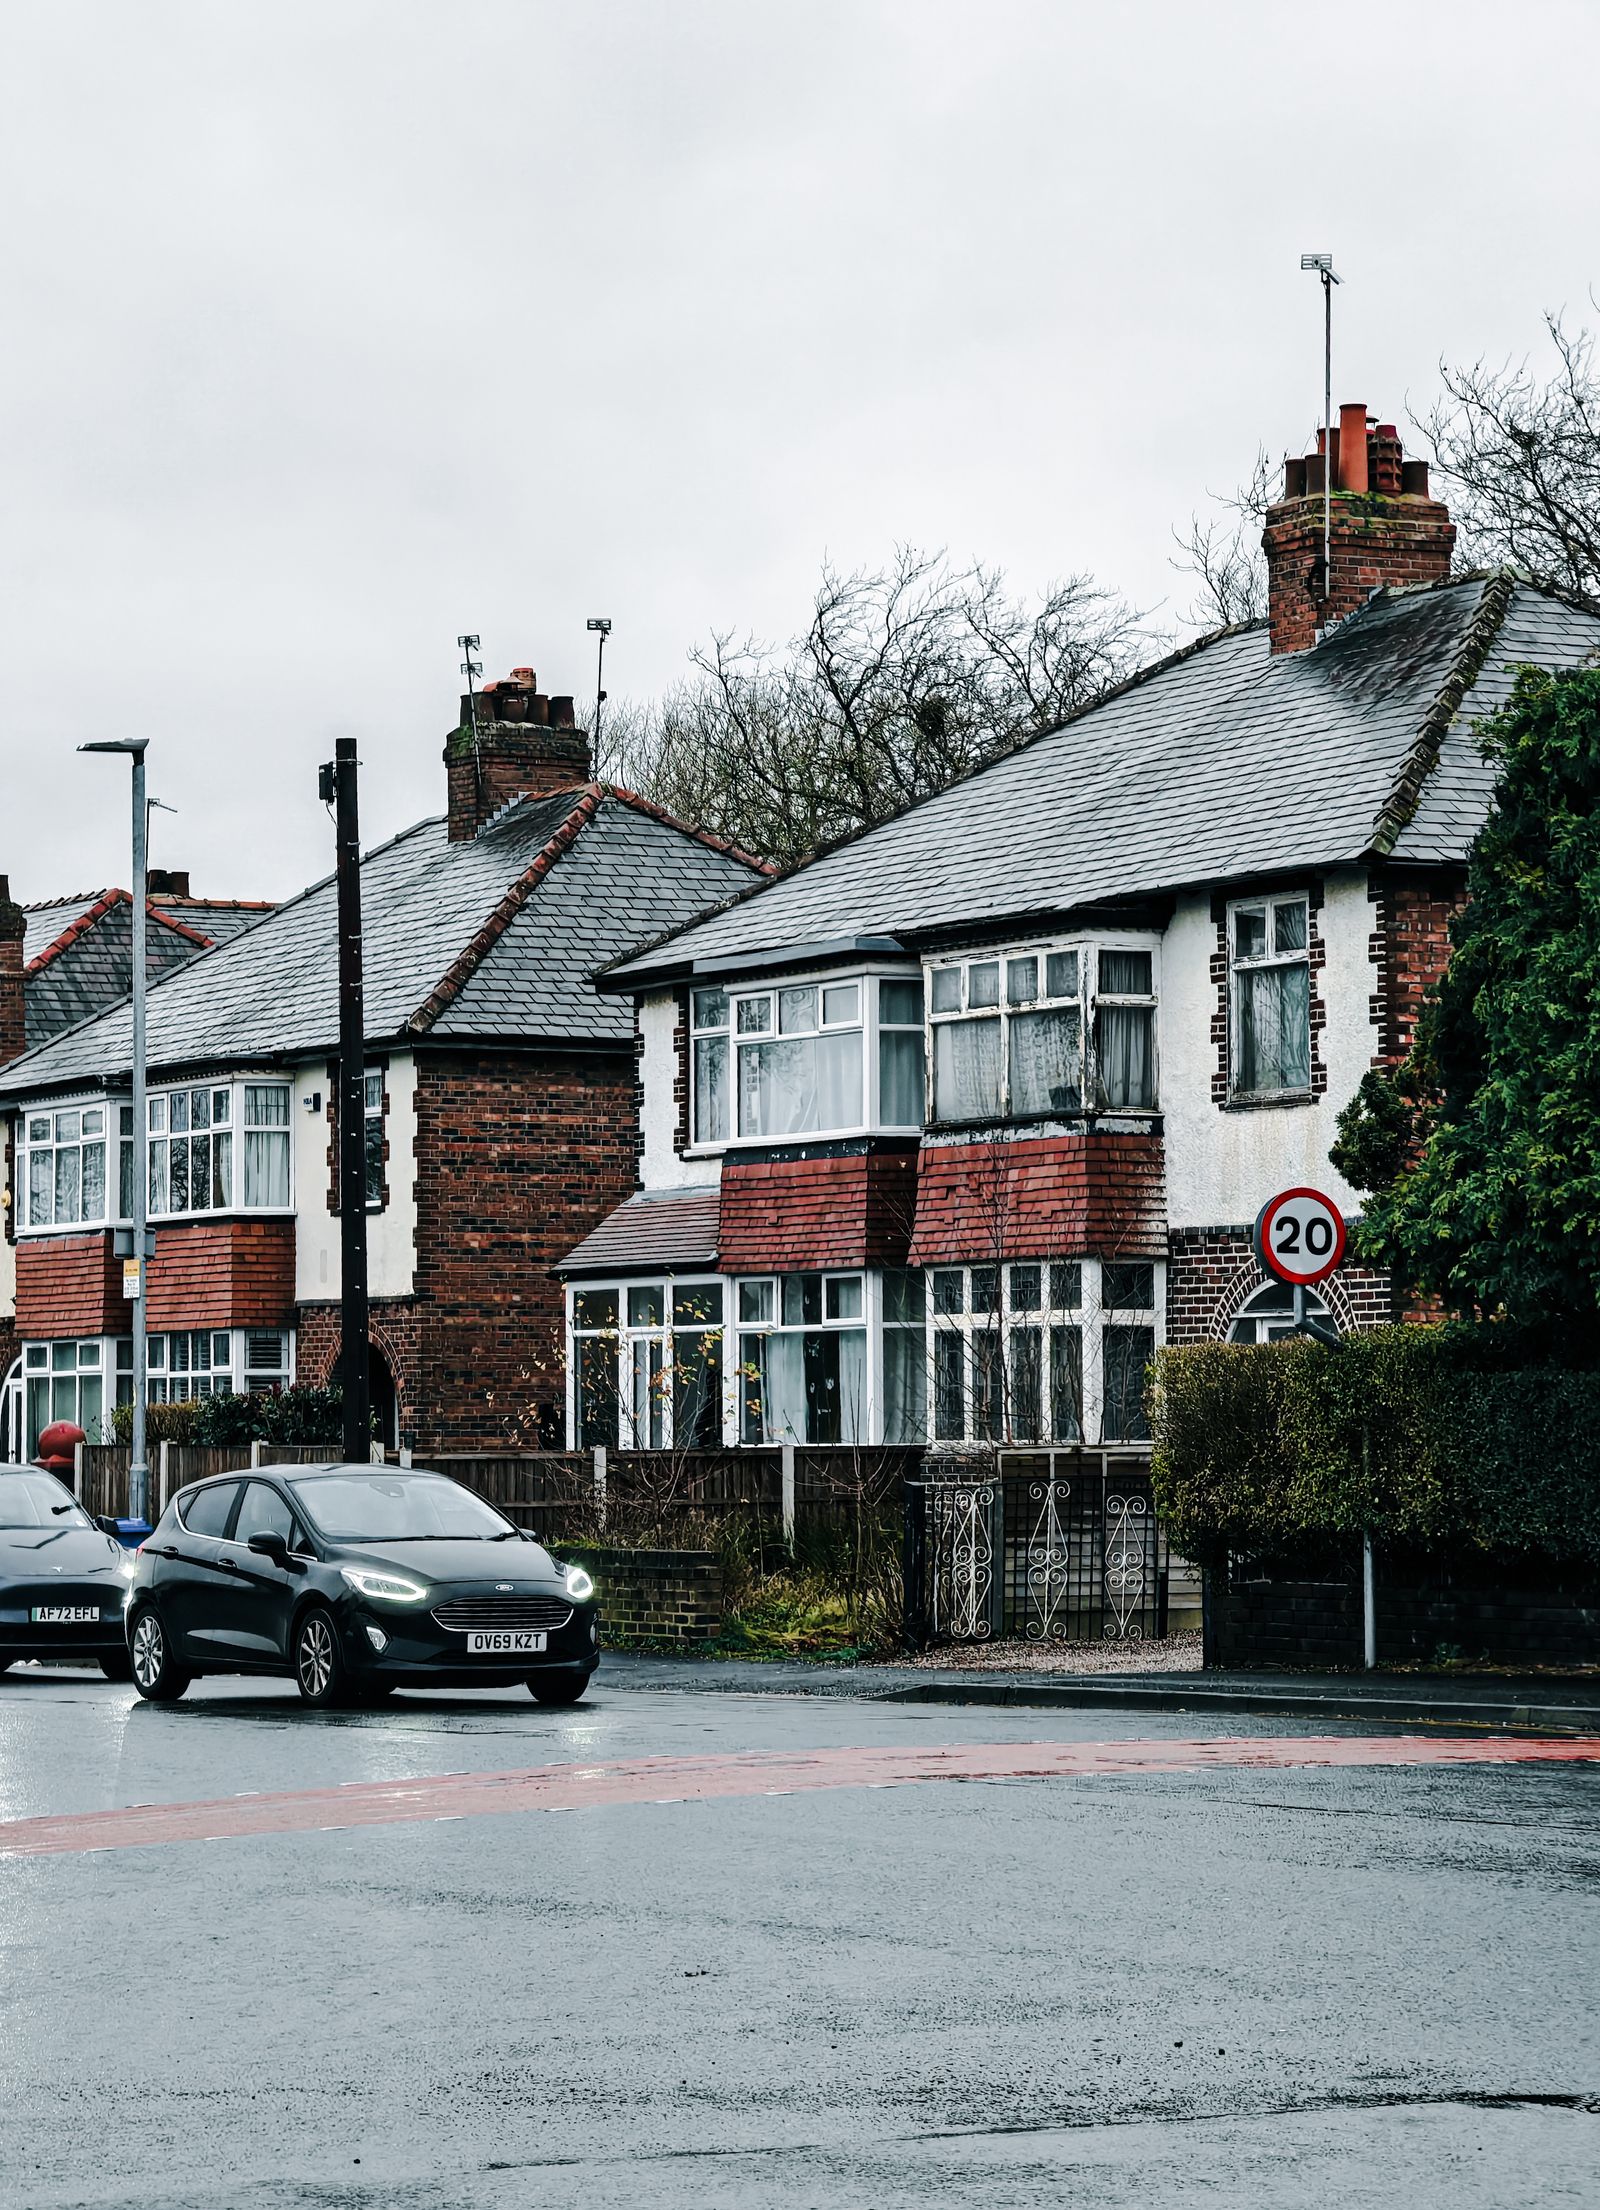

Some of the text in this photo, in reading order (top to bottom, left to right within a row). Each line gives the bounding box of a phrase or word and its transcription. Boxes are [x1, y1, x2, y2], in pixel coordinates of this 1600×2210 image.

[1275, 1216, 1333, 1256] 20
[40, 1607, 98, 1620] AF72 EFL
[474, 1633, 542, 1650] OV69 KZT
